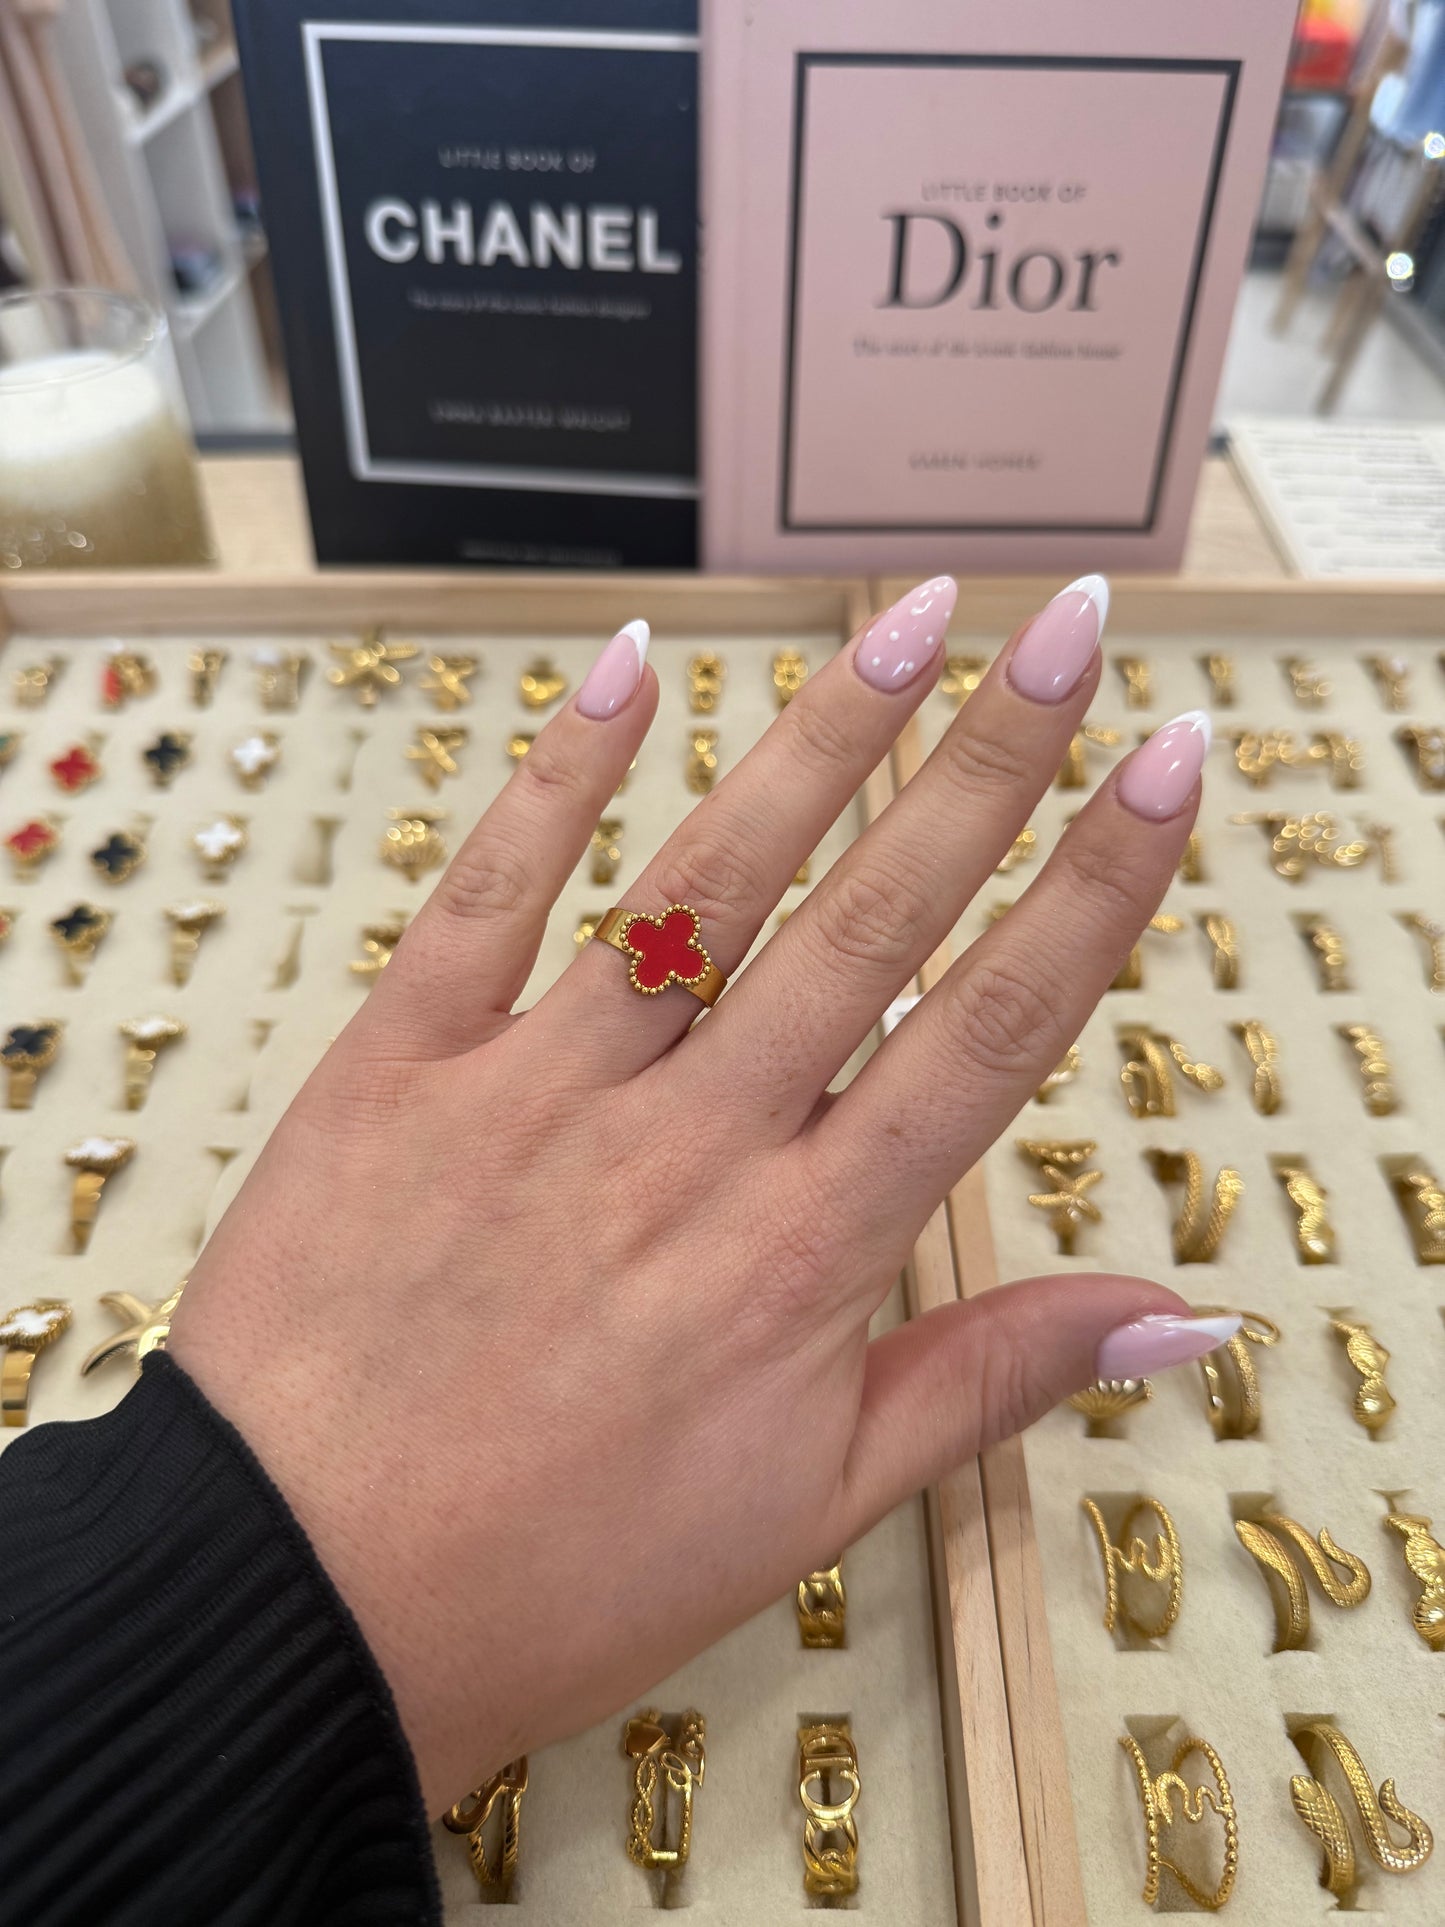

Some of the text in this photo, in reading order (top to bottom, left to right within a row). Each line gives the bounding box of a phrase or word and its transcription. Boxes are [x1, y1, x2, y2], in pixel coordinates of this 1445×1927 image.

[505, 148, 563, 172] BOOK
[921, 182, 1088, 204] LITTLE BOOK OF
[364, 196, 683, 275] CHANEL
[874, 207, 1121, 314] Dior
